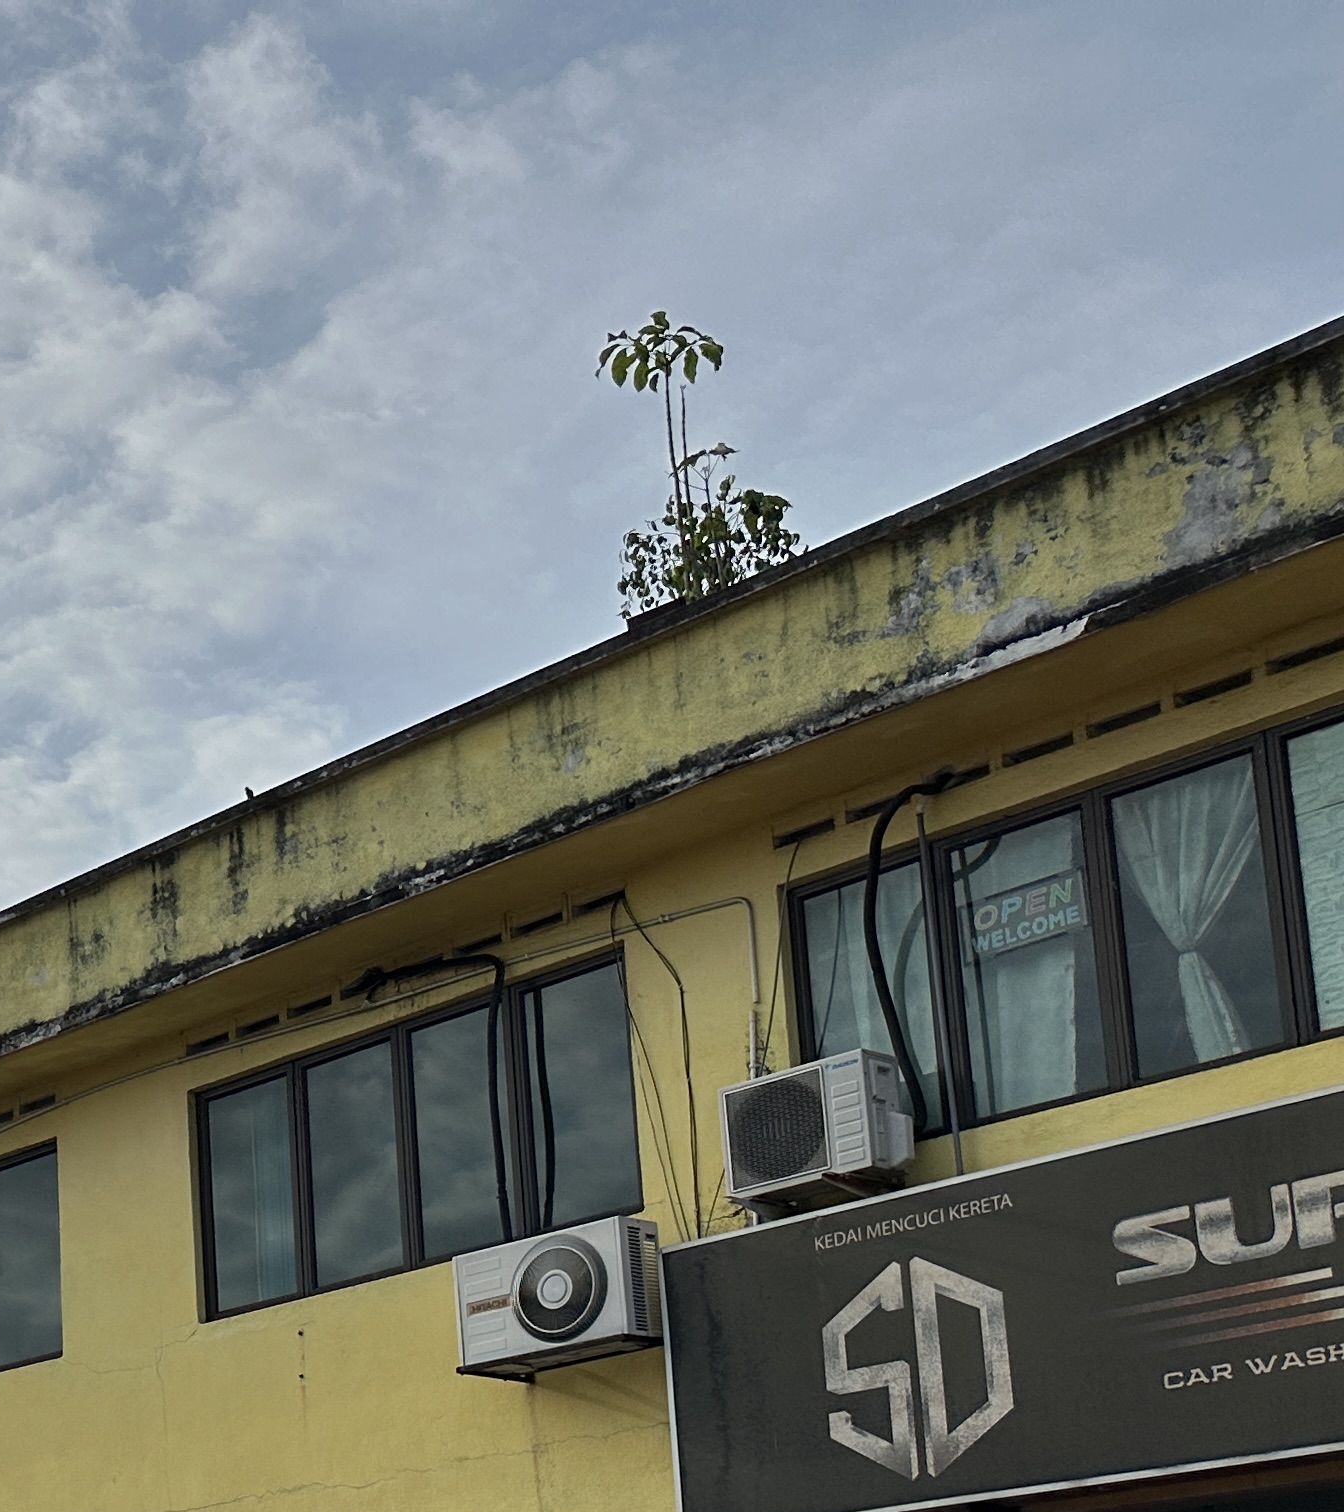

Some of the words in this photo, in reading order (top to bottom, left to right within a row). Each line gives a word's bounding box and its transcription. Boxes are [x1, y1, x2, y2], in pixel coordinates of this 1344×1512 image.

[971, 904, 1081, 953] WELCOME
[973, 878, 1075, 931] OPEN
[814, 1226, 862, 1251] KEDAI
[866, 1208, 945, 1239] MENCUCI
[949, 1192, 1014, 1222] KERETA
[472, 1298, 508, 1313] HITACHI
[1163, 1363, 1233, 1390] CAR
